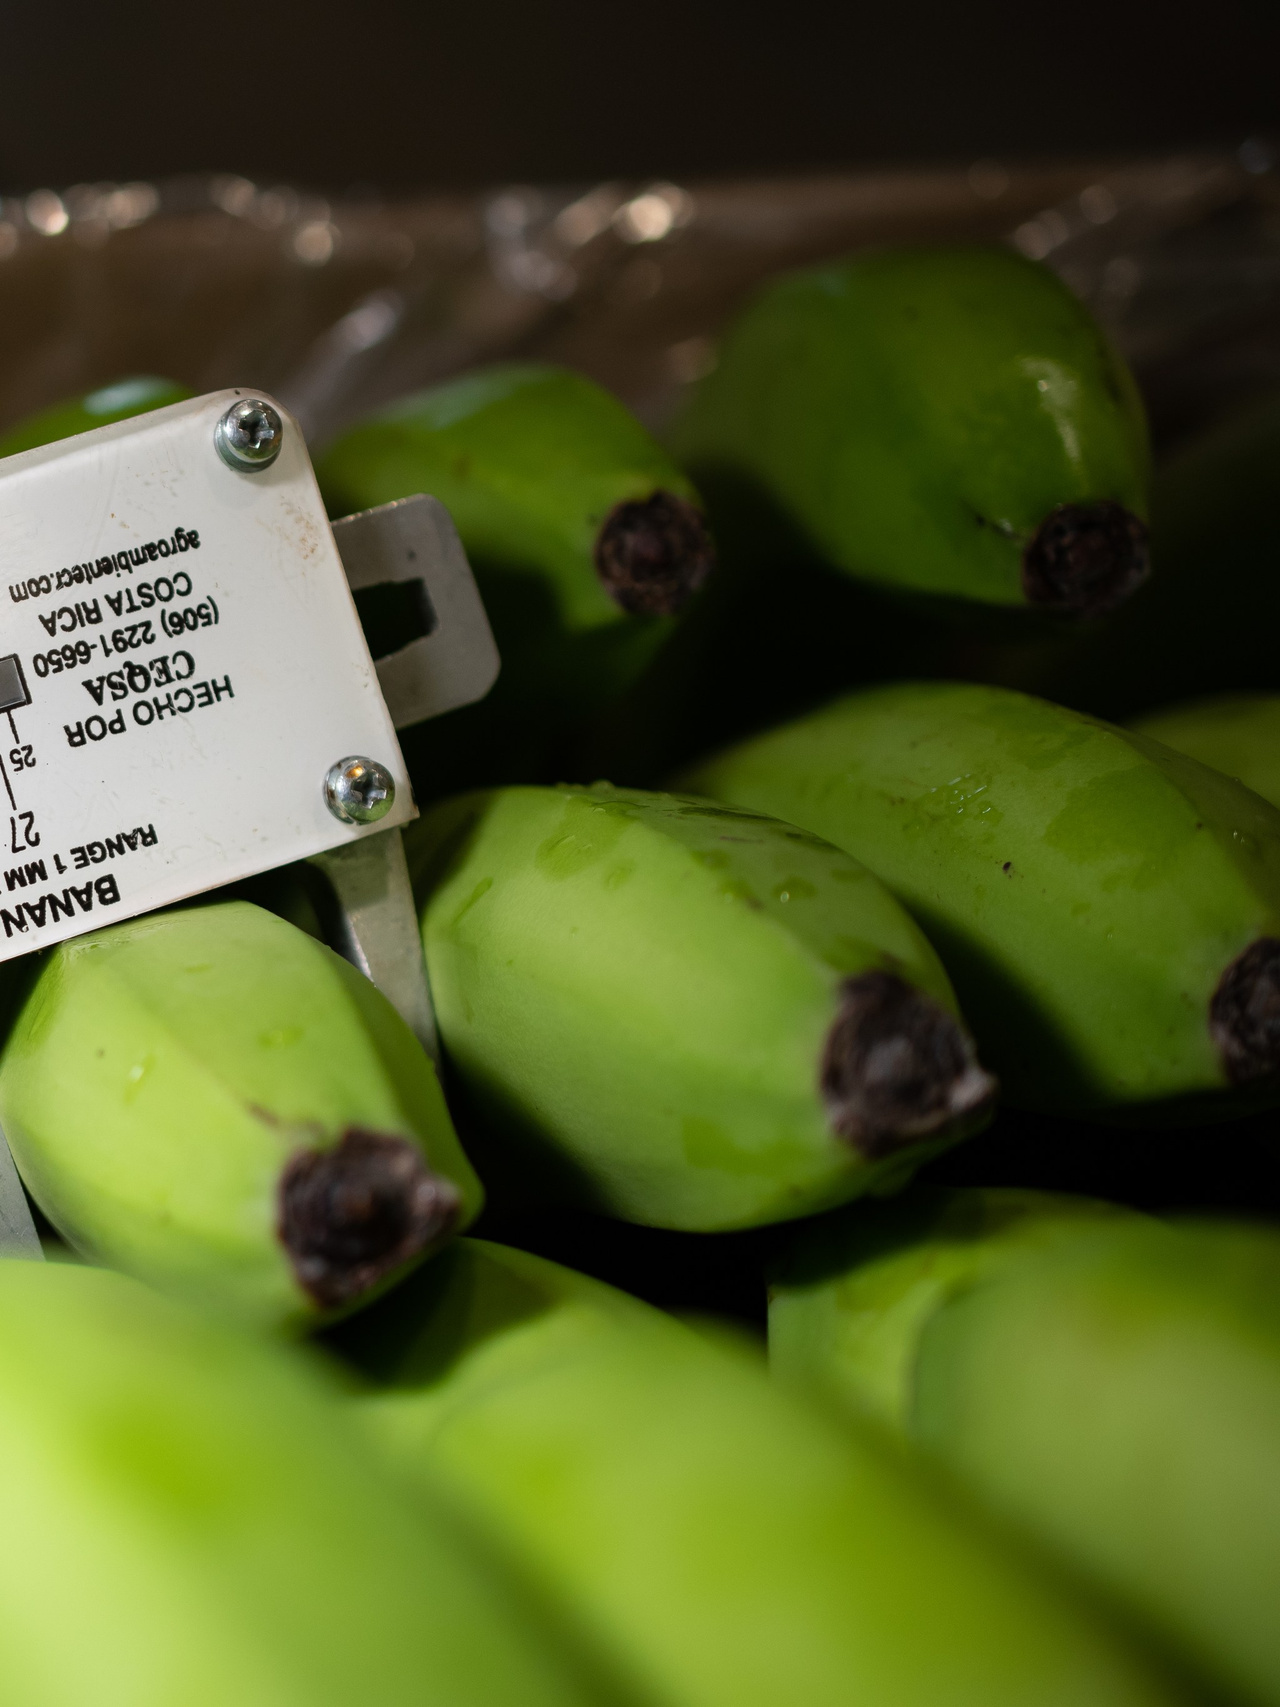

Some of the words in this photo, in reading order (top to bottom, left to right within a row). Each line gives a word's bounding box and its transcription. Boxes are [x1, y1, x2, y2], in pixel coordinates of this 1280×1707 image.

[9, 527, 201, 603] agroambientecr.com
[104, 571, 193, 616] COSTA
[38, 598, 103, 637] RICA
[161, 595, 219, 638] (506)
[32, 620, 156, 677] 2291-6650
[81, 650, 196, 706] CEQSA
[132, 675, 235, 726] HECHO
[63, 708, 126, 747] POR
[9, 744, 37, 772] 25
[10, 811, 41, 853] 27
[69, 824, 159, 870] RANGE
[4, 860, 48, 891] MM
[53, 854, 66, 873] 1
